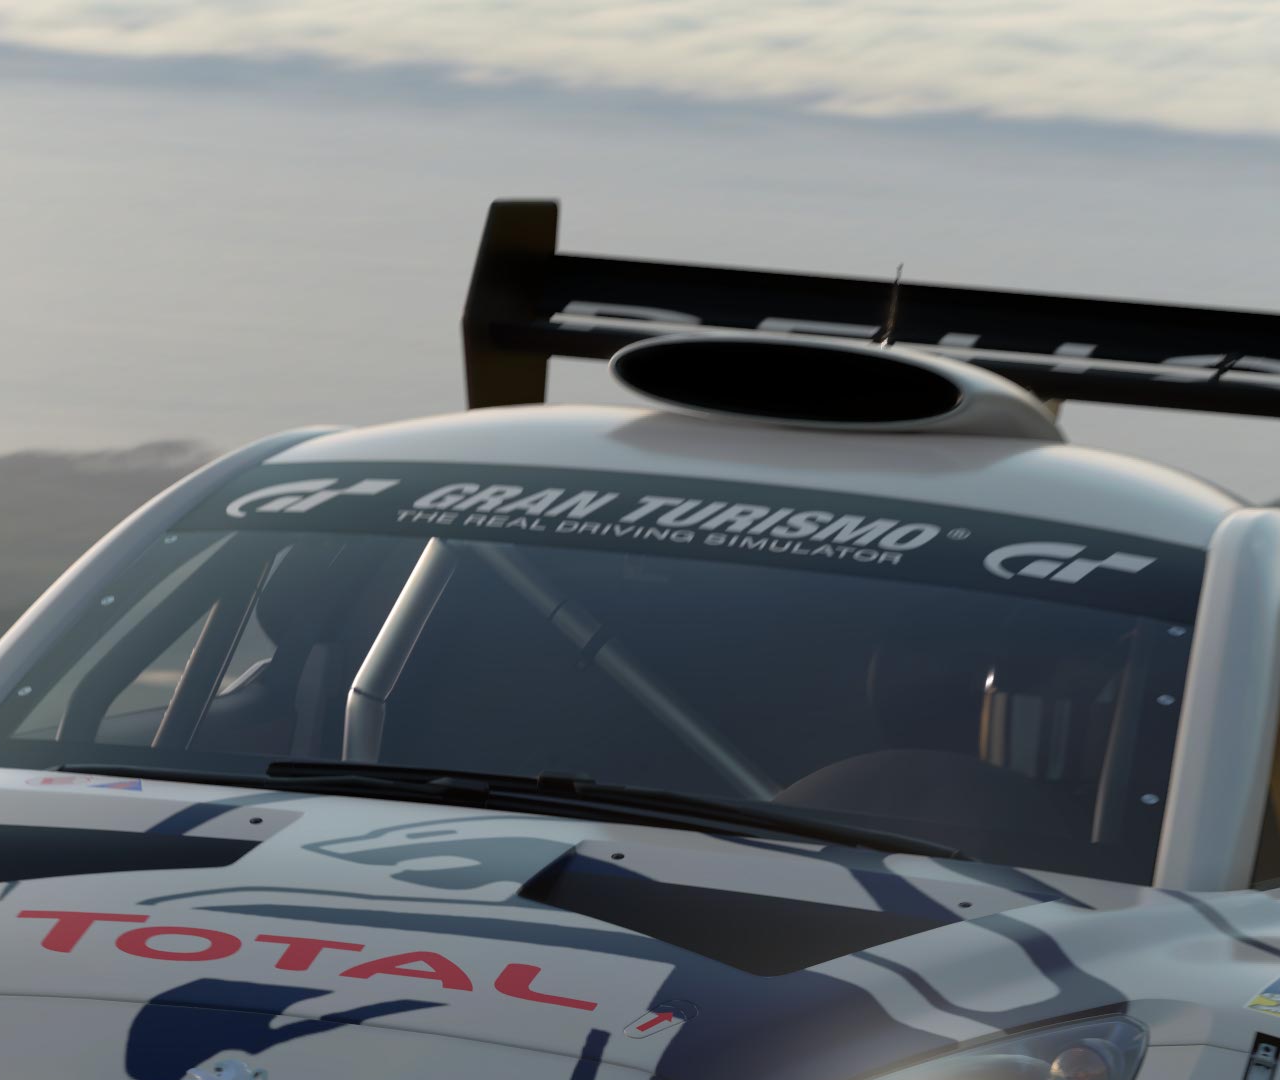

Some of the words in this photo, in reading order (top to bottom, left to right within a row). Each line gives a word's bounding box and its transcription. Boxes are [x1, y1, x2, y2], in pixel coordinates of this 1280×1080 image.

[413, 482, 621, 519] GRAN
[397, 509, 459, 525] THE
[463, 513, 547, 531] REAL
[554, 519, 696, 544] DRIVING
[704, 532, 904, 565] SIMULATOR
[16, 909, 599, 1012] TOTAL
